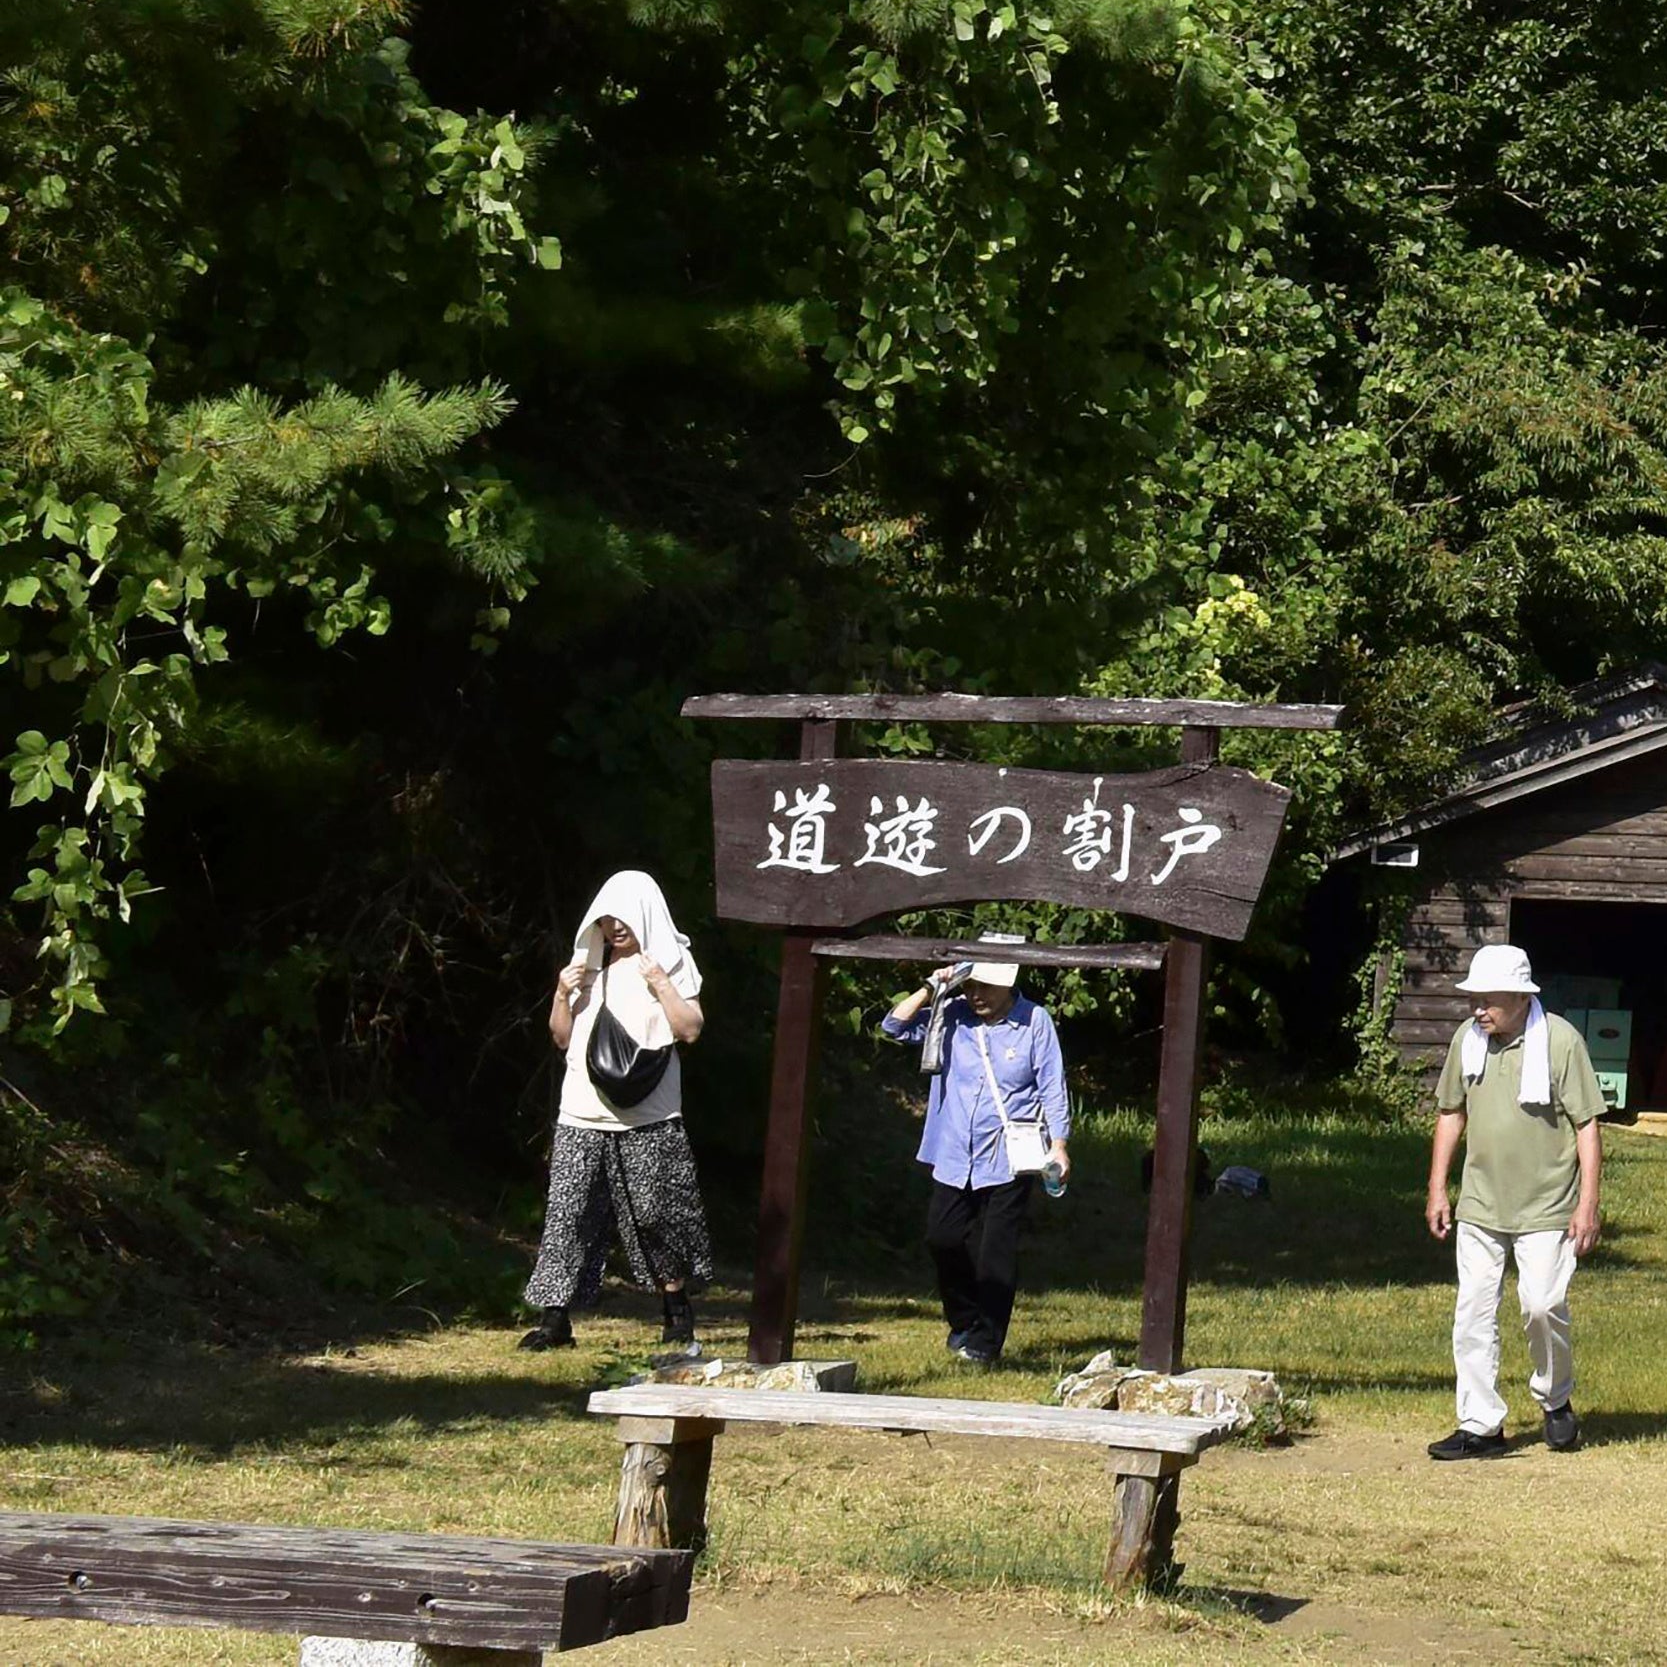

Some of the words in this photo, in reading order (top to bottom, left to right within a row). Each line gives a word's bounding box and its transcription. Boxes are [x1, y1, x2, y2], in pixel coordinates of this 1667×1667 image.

[757, 783, 1223, 886] 道遊の割戸
